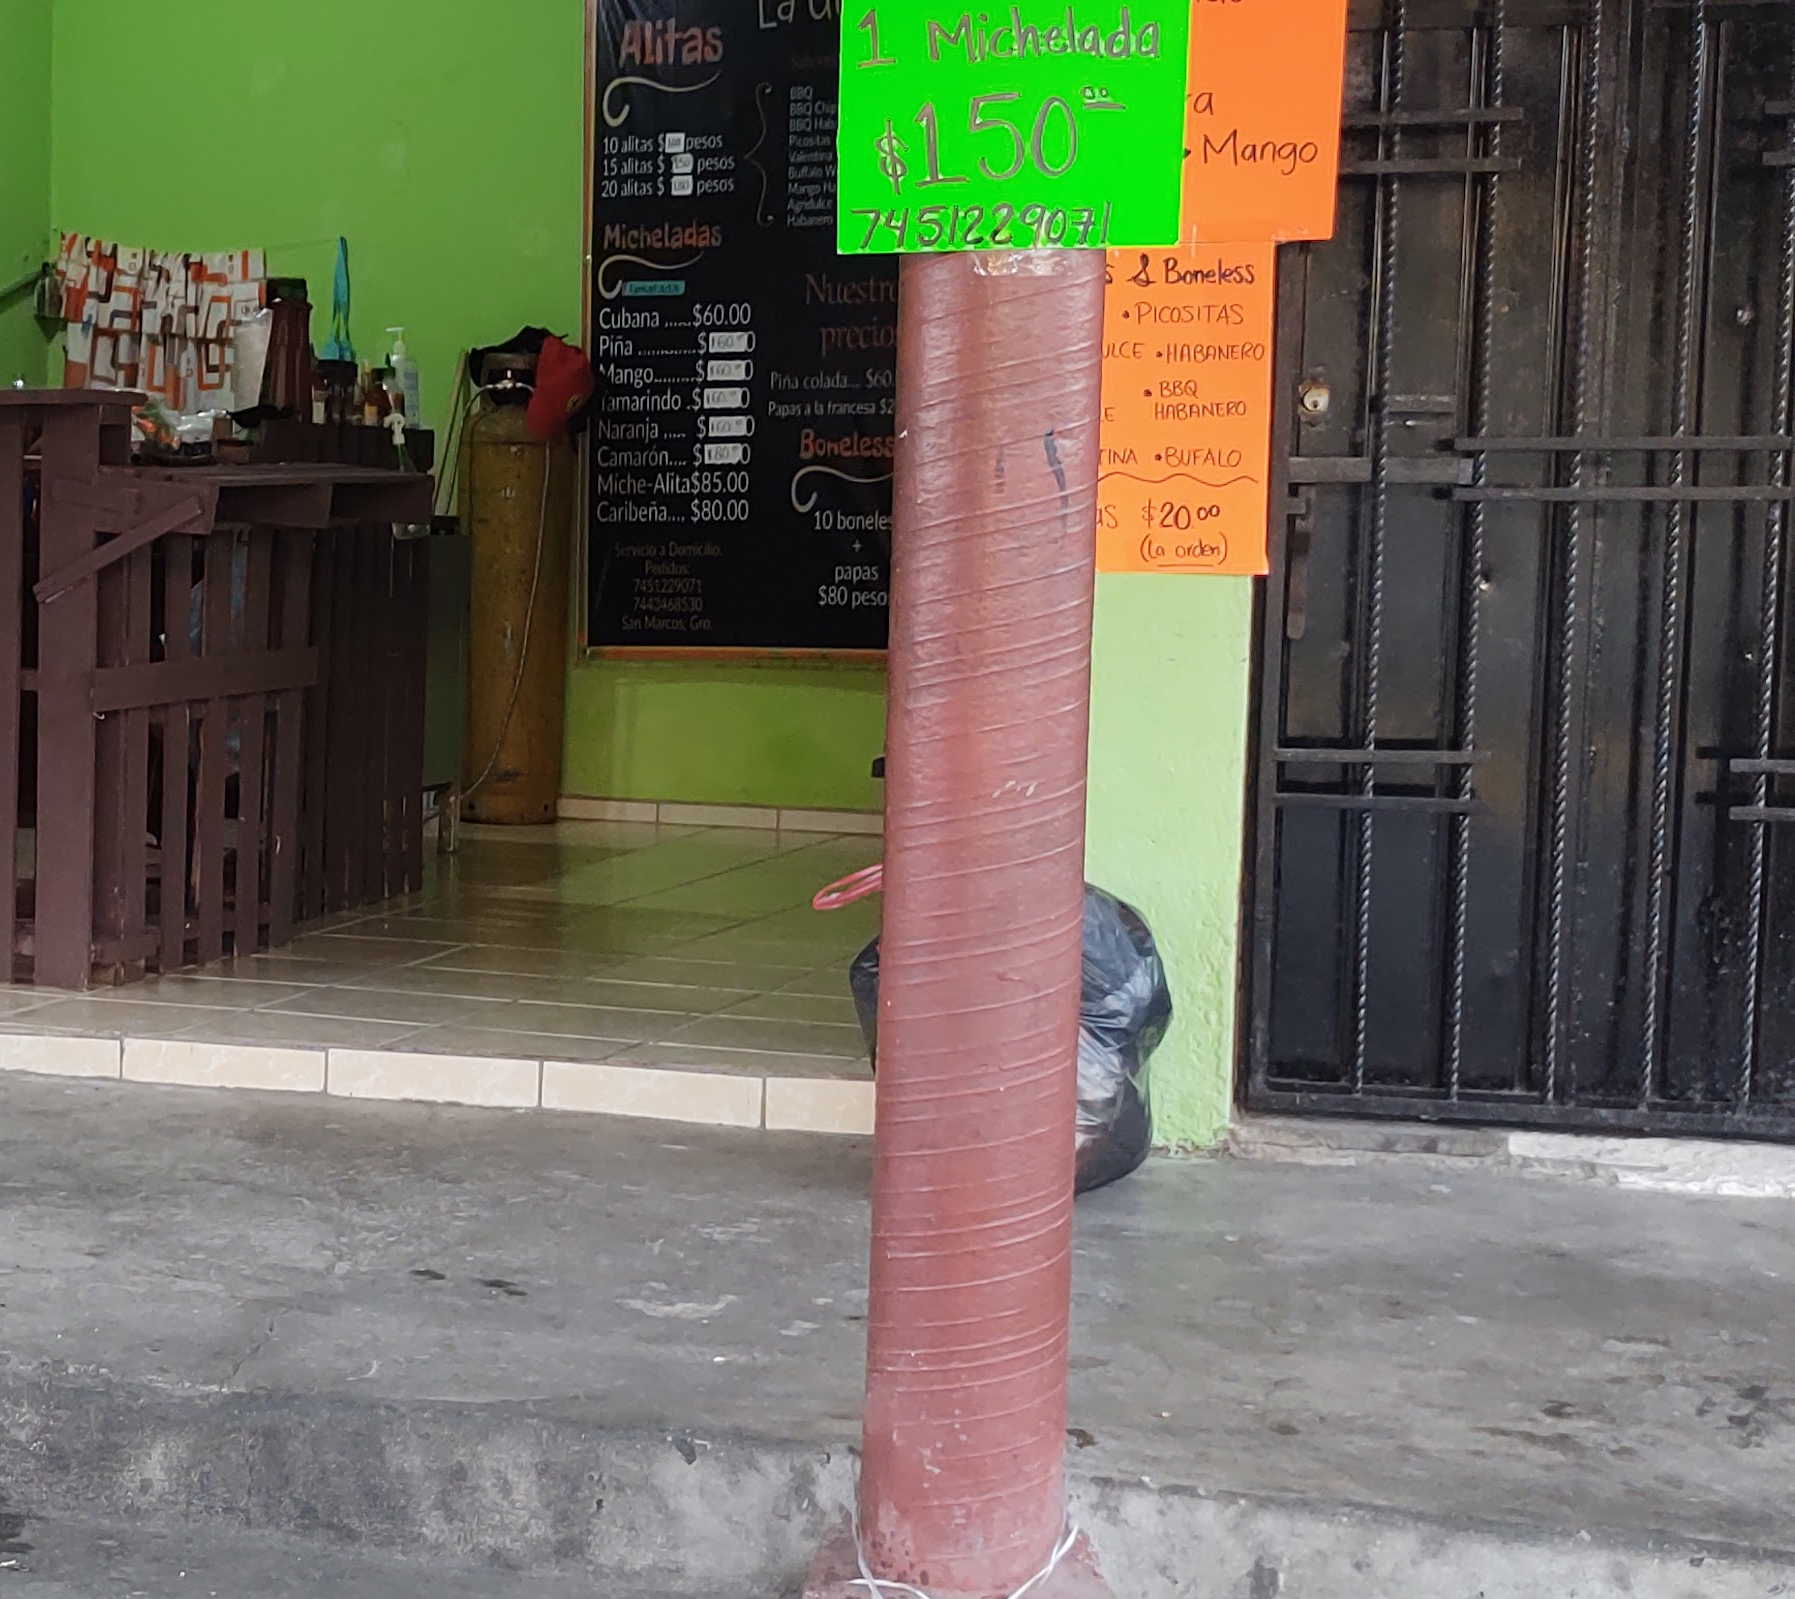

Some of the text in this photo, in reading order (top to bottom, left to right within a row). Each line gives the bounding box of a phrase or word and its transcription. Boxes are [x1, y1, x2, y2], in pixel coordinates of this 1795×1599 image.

[618, 16, 724, 69] Alitas
[857, 5, 1160, 68] 1 Michelada
[790, 86, 813, 100] BBQ
[789, 102, 812, 116] BBQ
[789, 118, 812, 132] BBQ
[604, 136, 618, 154] 10
[621, 135, 653, 153] alitas
[685, 134, 723, 151] pesos
[1204, 128, 1318, 176] Mango
[604, 158, 618, 176] 15
[621, 157, 653, 175] alitas
[697, 155, 735, 175] pesos
[601, 180, 618, 197] 20
[621, 179, 653, 196] alitas
[697, 177, 735, 196] pesos
[604, 220, 723, 249] Micheladas
[850, 200, 1112, 249] 7451229071
[1163, 256, 1255, 286] Boneless
[599, 302, 751, 329] Cubana $60.00
[1135, 301, 1245, 326] PICOSITAS
[599, 335, 633, 357] Piña
[1166, 341, 1266, 364] HABANERO
[1159, 379, 1199, 399] BBQ
[768, 401, 801, 418] Papas
[1154, 400, 1247, 421] HABANERO
[598, 417, 659, 443] Naranja
[1165, 446, 1242, 468] BUFALO
[690, 498, 749, 523] $80.00
[814, 510, 833, 530] 10
[835, 565, 879, 585] papas
